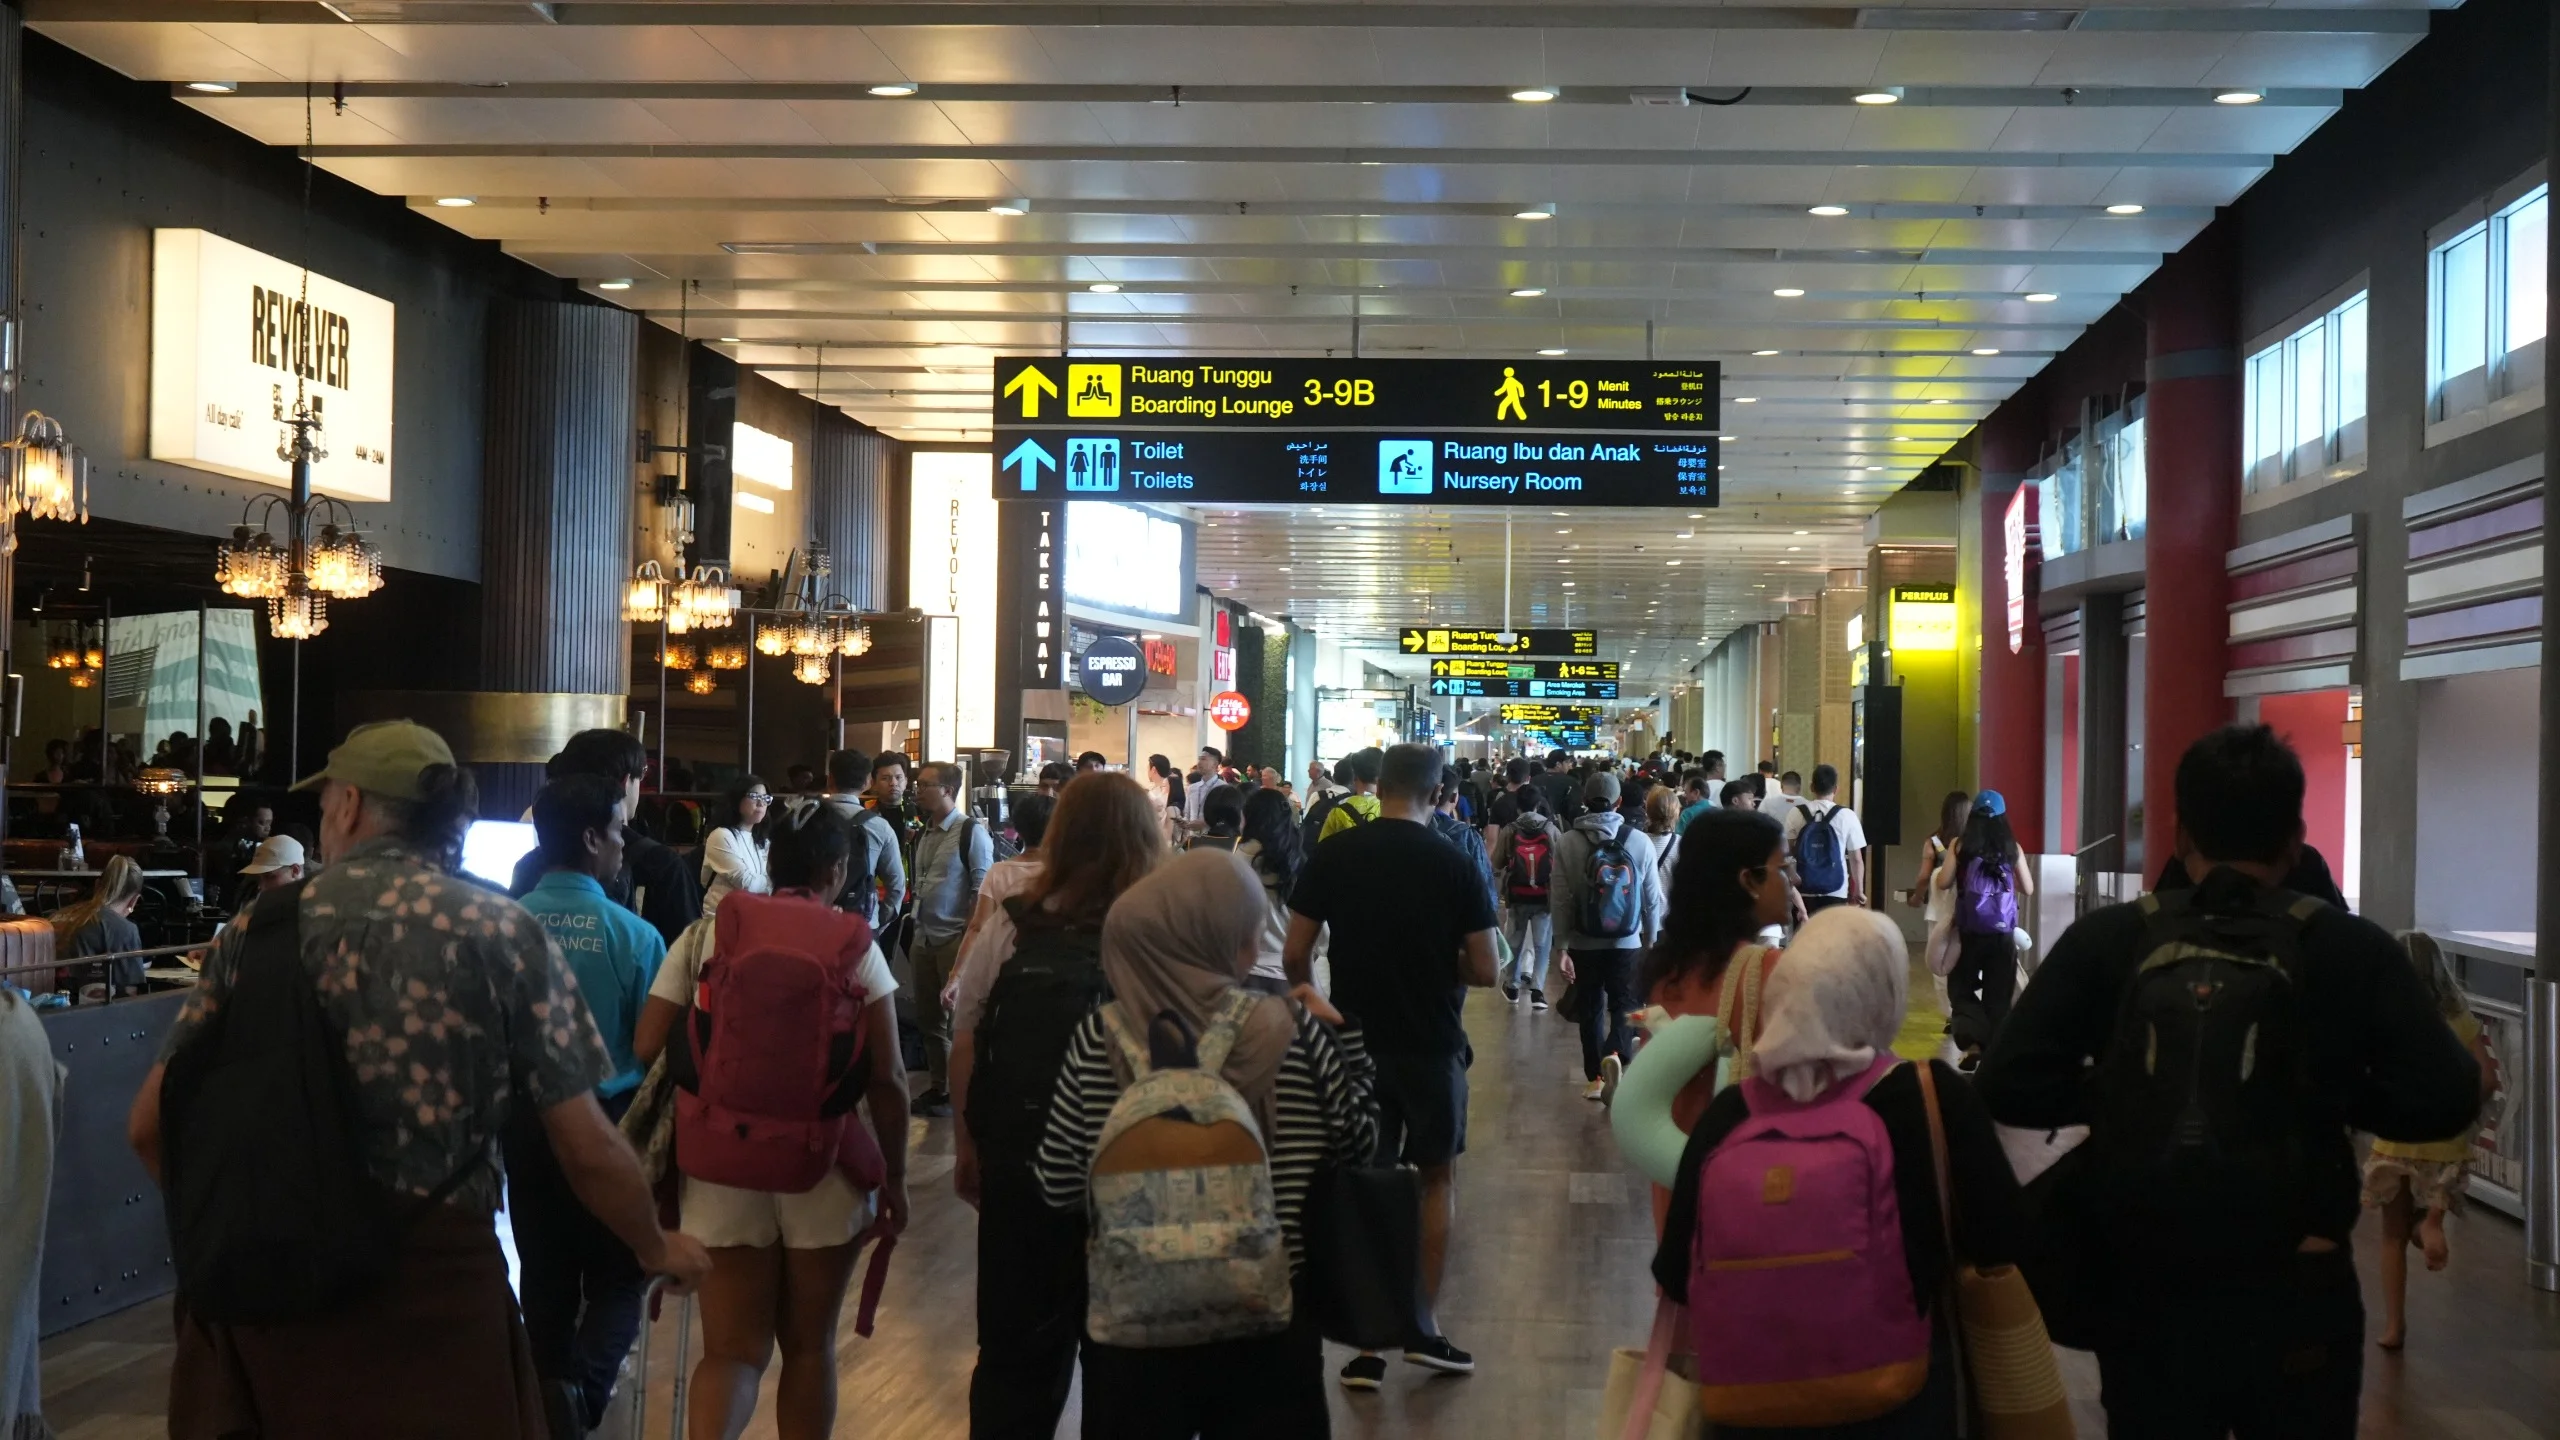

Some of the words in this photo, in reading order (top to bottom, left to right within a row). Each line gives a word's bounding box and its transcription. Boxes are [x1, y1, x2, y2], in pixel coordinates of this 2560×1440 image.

[252, 284, 350, 391] REVOLVER
[1131, 365, 1194, 388] Ruang
[1199, 365, 1272, 388] Tunggu
[1598, 380, 1630, 392] Menit
[1303, 378, 1375, 406] 3-9B
[1538, 379, 1589, 409] 1-9
[205, 402, 216, 424] All
[1131, 395, 1217, 418] Boarding
[1222, 395, 1294, 419] Lounge
[1597, 397, 1643, 410] Minutes
[1130, 441, 1184, 460] Toilet
[1443, 441, 1508, 465] Ruang
[1513, 442, 1543, 461] Ibu
[1547, 442, 1585, 461] dan
[1589, 443, 1641, 462] Anak
[1129, 470, 1194, 490] Toilets
[1297, 467, 1327, 478] トイレ
[1299, 481, 1327, 492] 화장실
[1443, 471, 1520, 494] Nursery
[1525, 471, 1583, 491] Room
[949, 499, 959, 613] REVOLV
[1038, 511, 1051, 589] TAKE
[1901, 591, 1949, 601] PERIPLUS
[1036, 601, 1051, 679] AWAY
[1451, 631, 1478, 642] Ruang
[1479, 631, 1499, 642] Tung
[1520, 636, 1530, 649] 3
[1451, 642, 1487, 653] Boarding
[1088, 656, 1137, 671] ESPRESSO
[1570, 665, 1586, 676] 1-6
[1101, 672, 1123, 687] BAR
